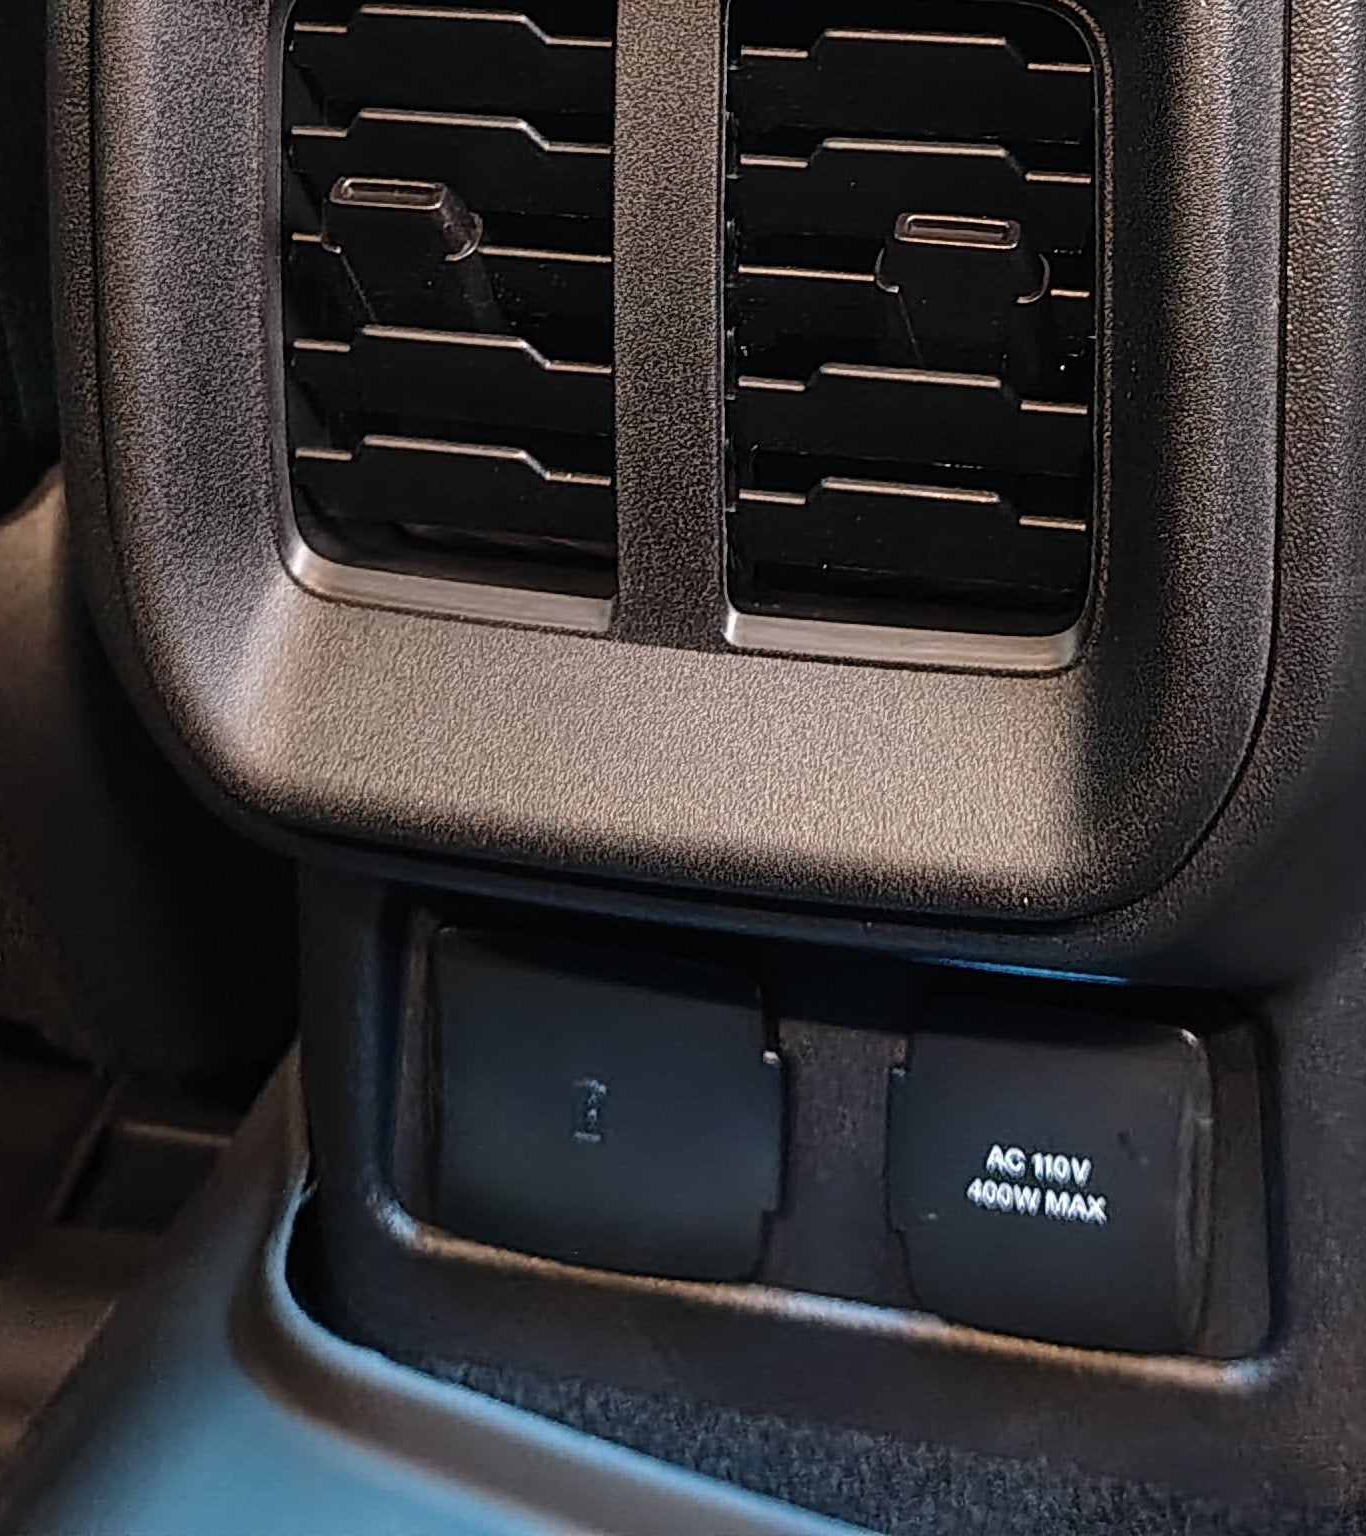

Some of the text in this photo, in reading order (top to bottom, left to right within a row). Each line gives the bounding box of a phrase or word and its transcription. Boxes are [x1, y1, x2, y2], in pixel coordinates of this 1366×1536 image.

[986, 1144, 1092, 1186] AC 110V
[967, 1178, 1107, 1225] 400W MAX
